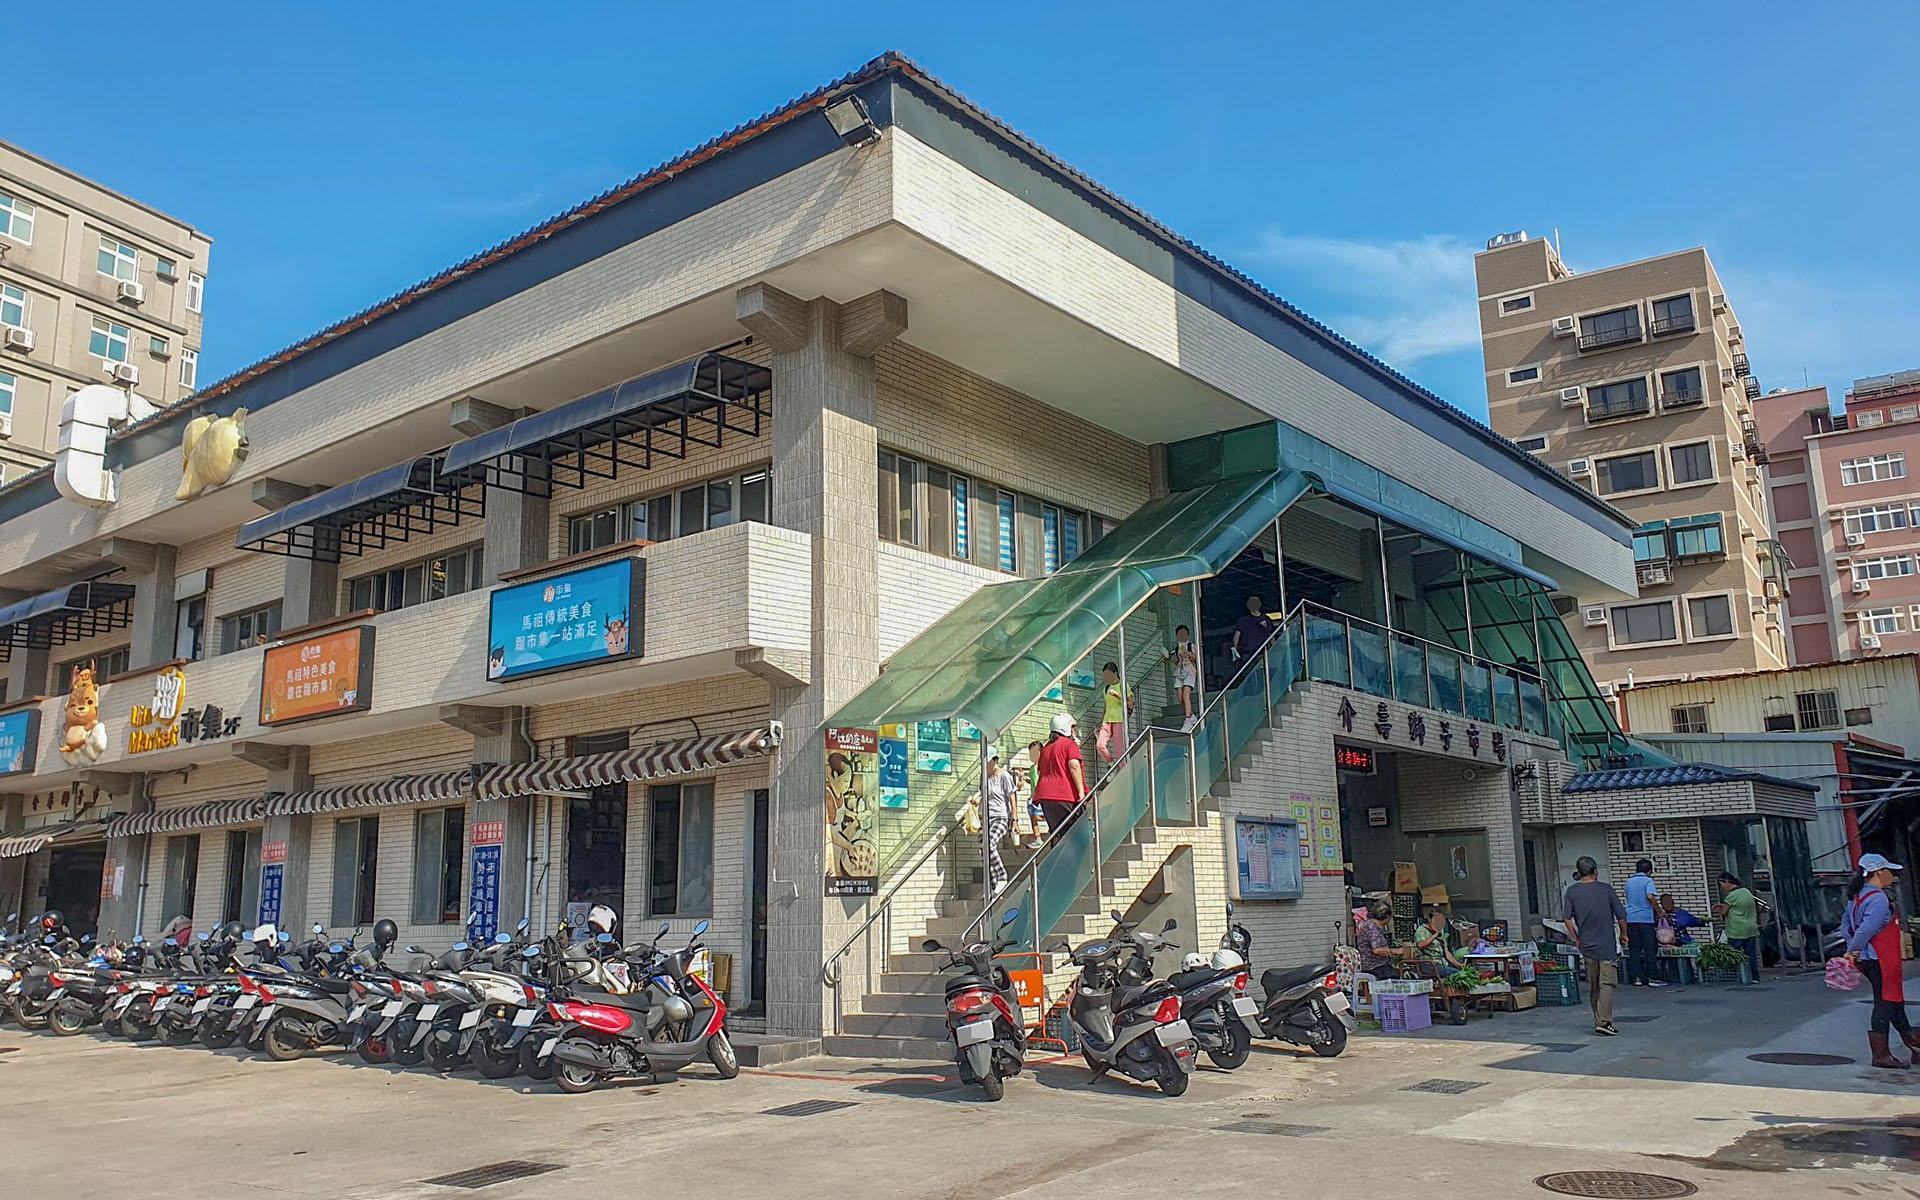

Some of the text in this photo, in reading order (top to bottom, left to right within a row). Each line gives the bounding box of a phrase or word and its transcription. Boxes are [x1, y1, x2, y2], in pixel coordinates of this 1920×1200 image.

[522, 601, 592, 631] 馬祖傳統美食
[286, 660, 336, 683] 馬祖特色美食
[128, 723, 179, 754] Market
[223, 716, 242, 736] 2F
[1338, 695, 1507, 762] 介壽獅子市場
